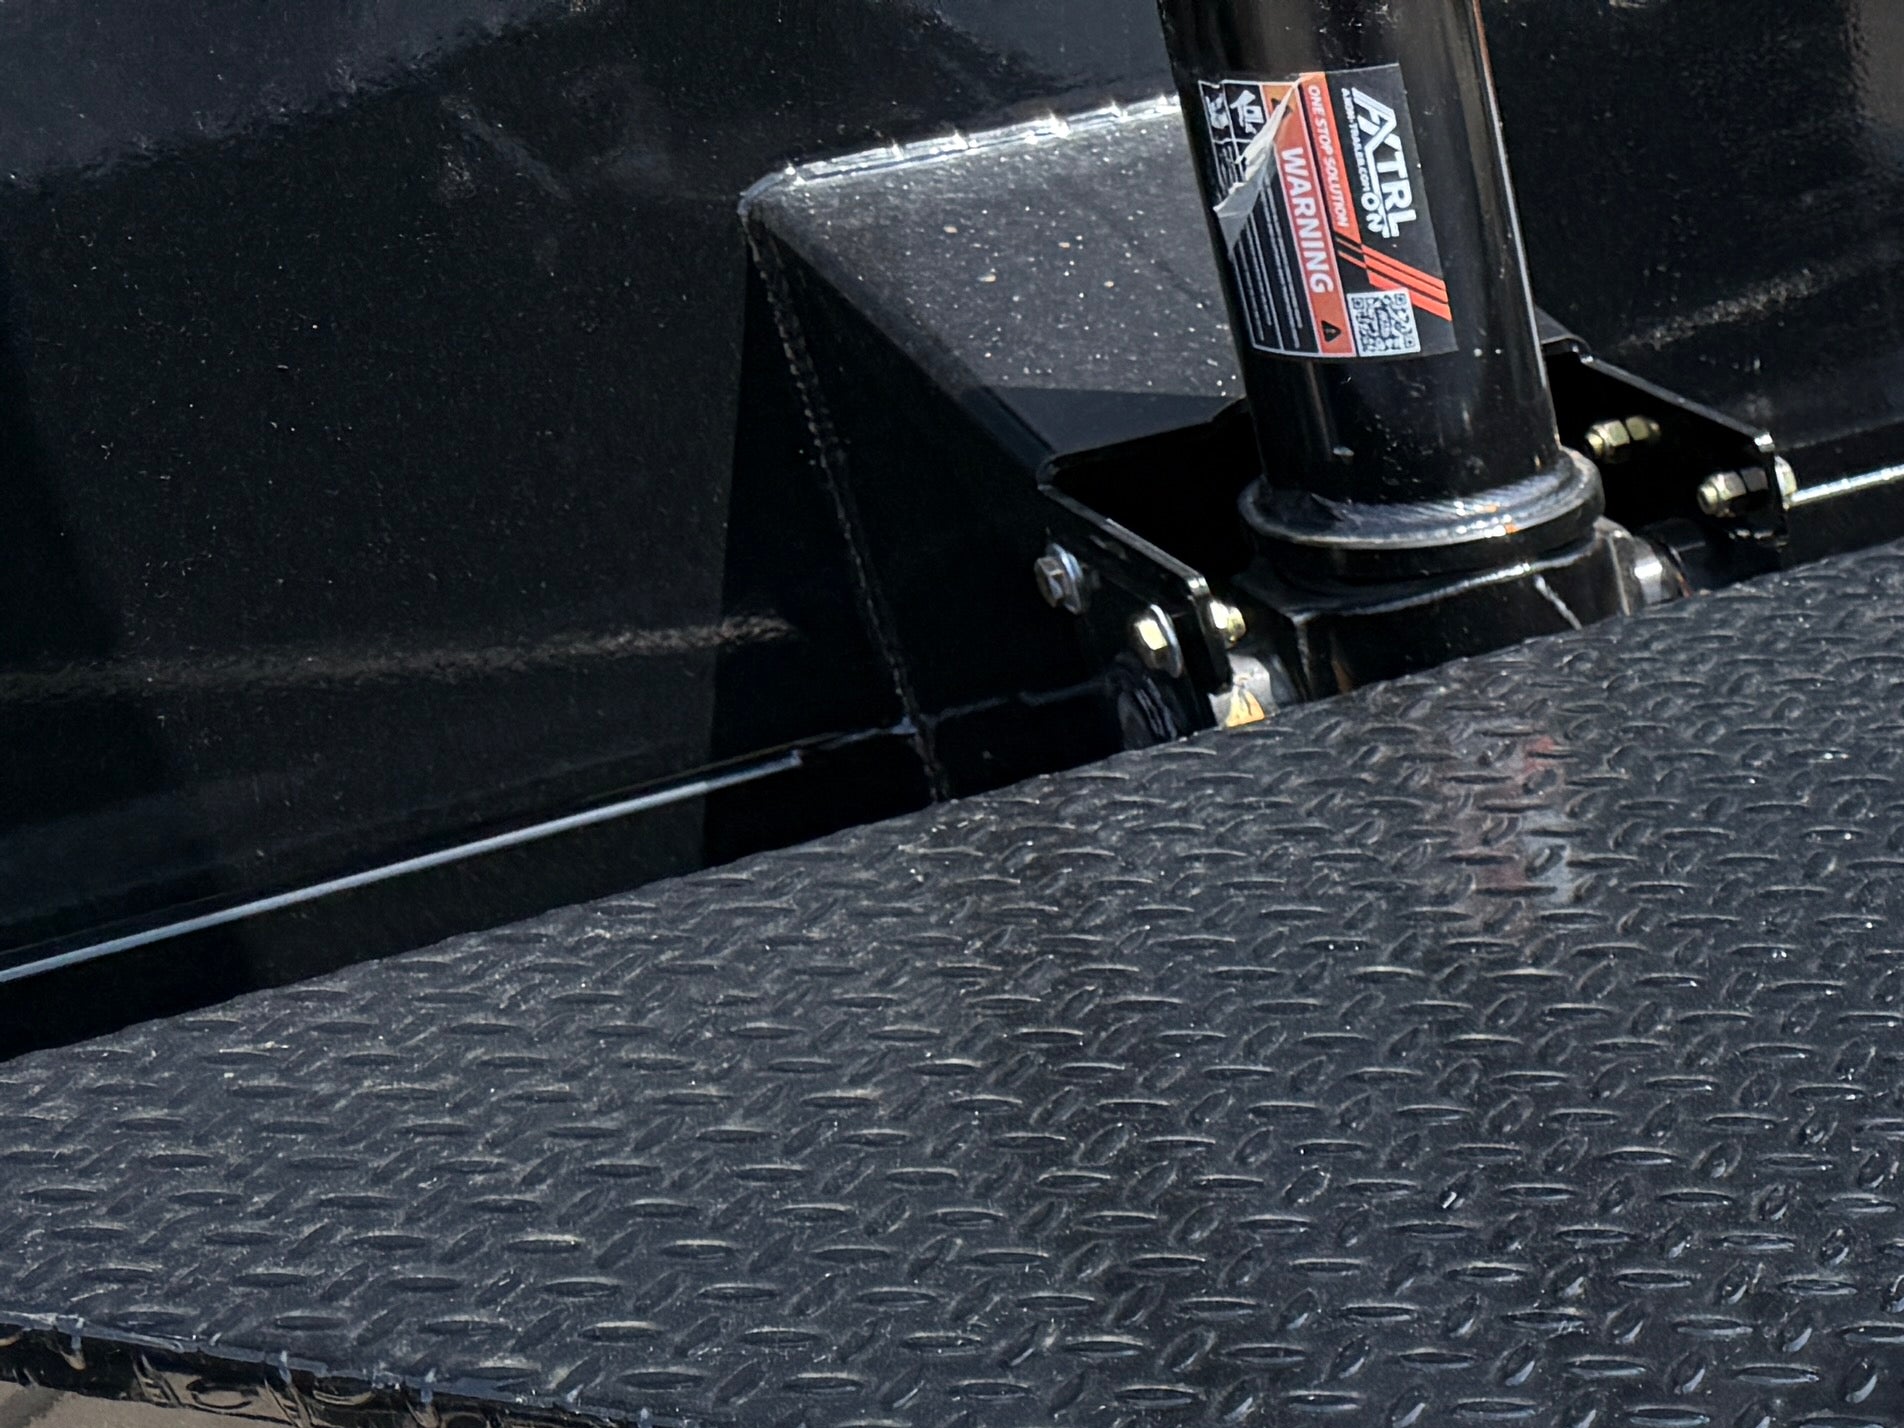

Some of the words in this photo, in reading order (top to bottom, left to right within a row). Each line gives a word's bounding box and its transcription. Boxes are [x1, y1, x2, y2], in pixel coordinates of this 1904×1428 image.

[1308, 85, 1325, 116] ONE
[1314, 117, 1333, 154] STOP
[1281, 146, 1335, 294] WARNING
[1323, 156, 1349, 229] SOLUTION
